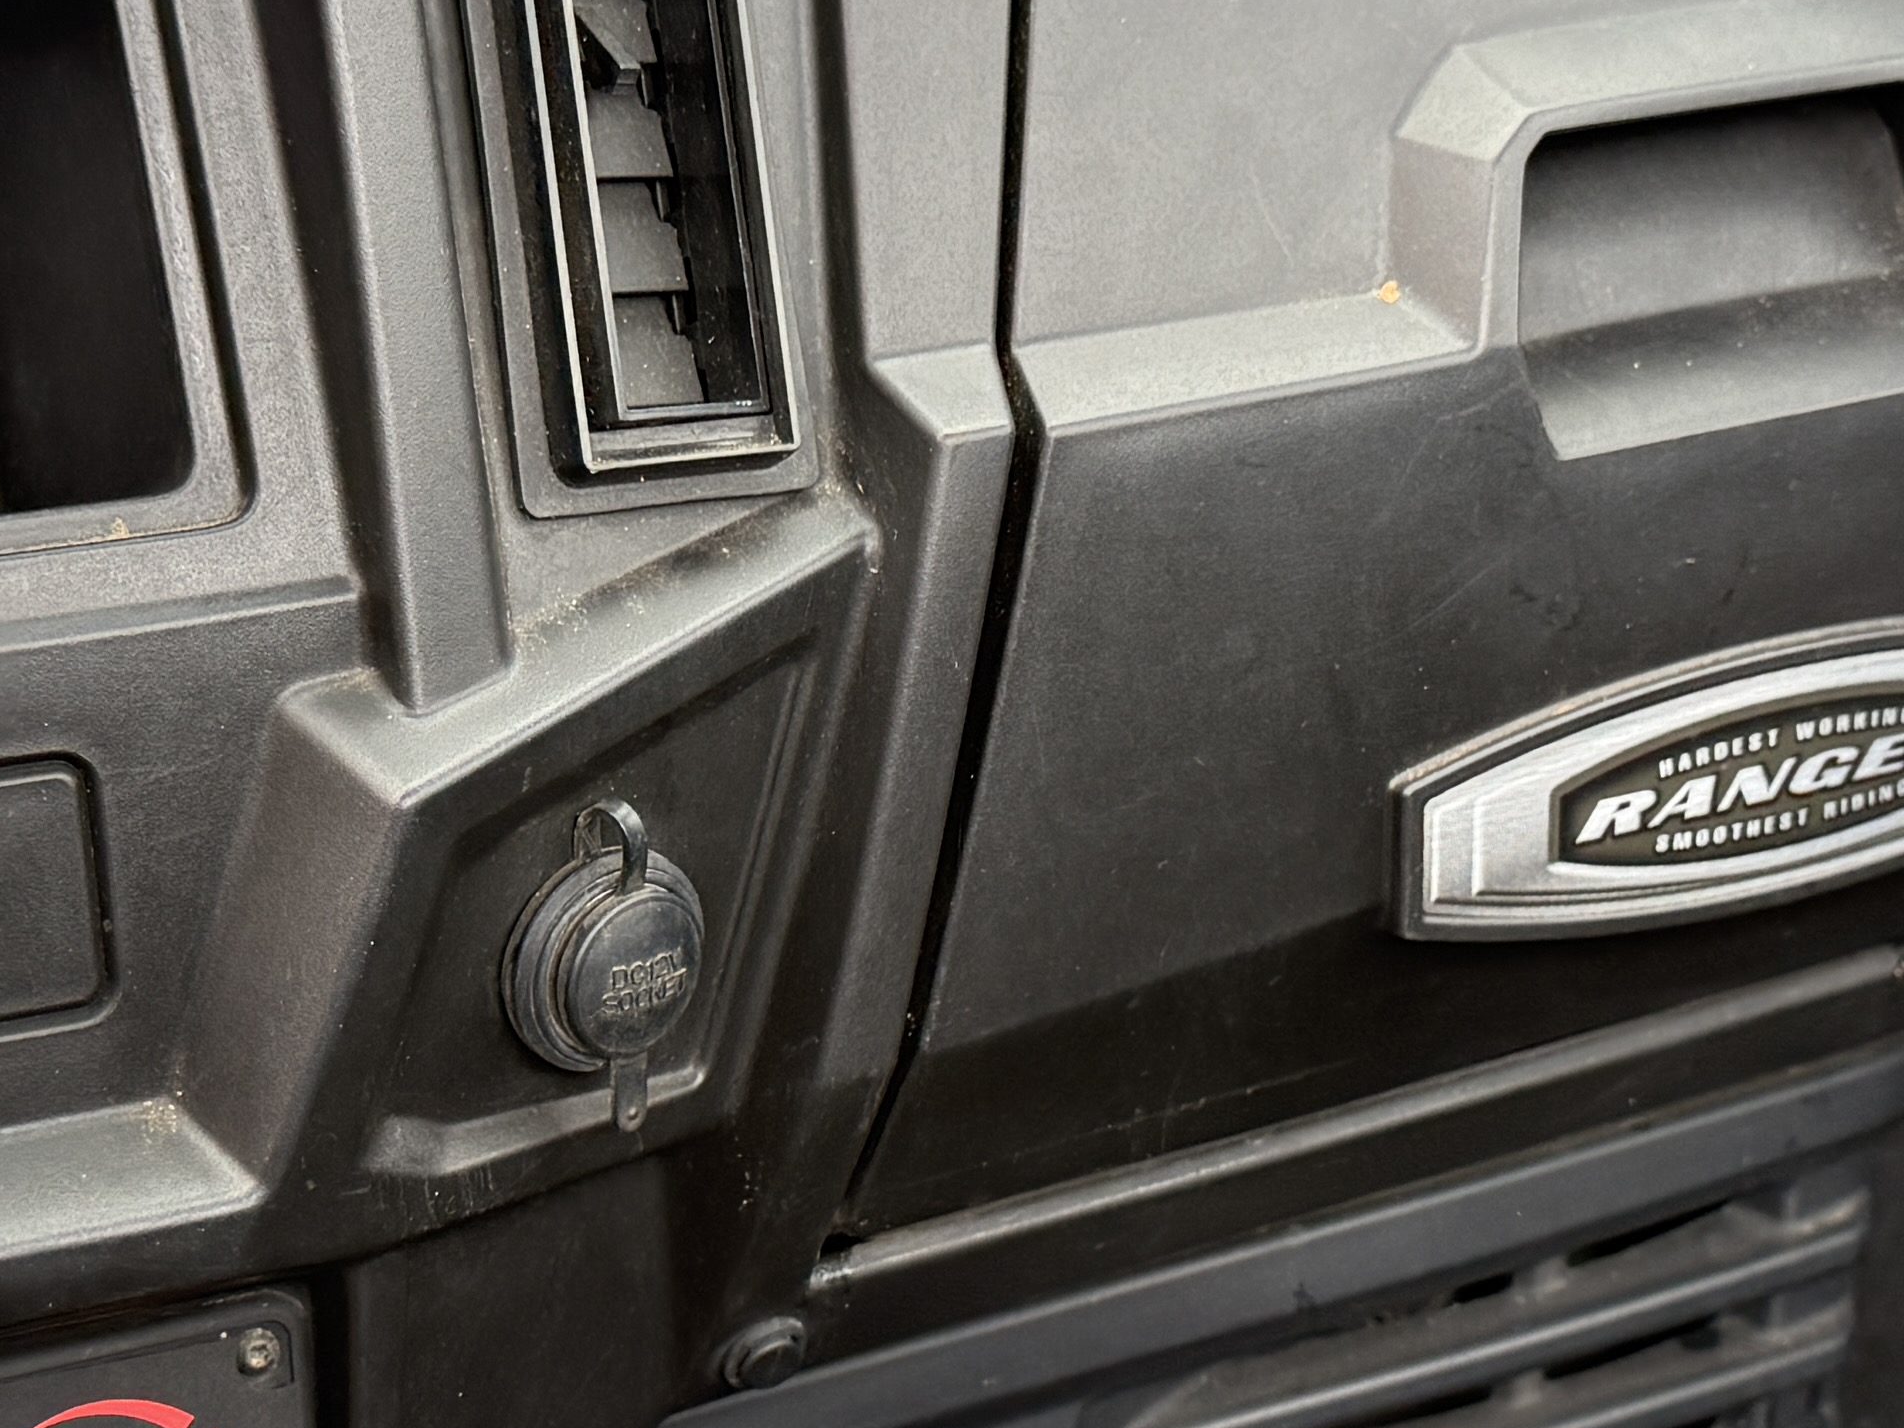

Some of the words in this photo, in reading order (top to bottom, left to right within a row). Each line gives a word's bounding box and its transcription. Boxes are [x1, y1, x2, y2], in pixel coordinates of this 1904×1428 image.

[1658, 728, 1781, 778] HARDEST
[1654, 807, 1808, 853] SMOOTHEST
[601, 967, 687, 1013] SOCKET
